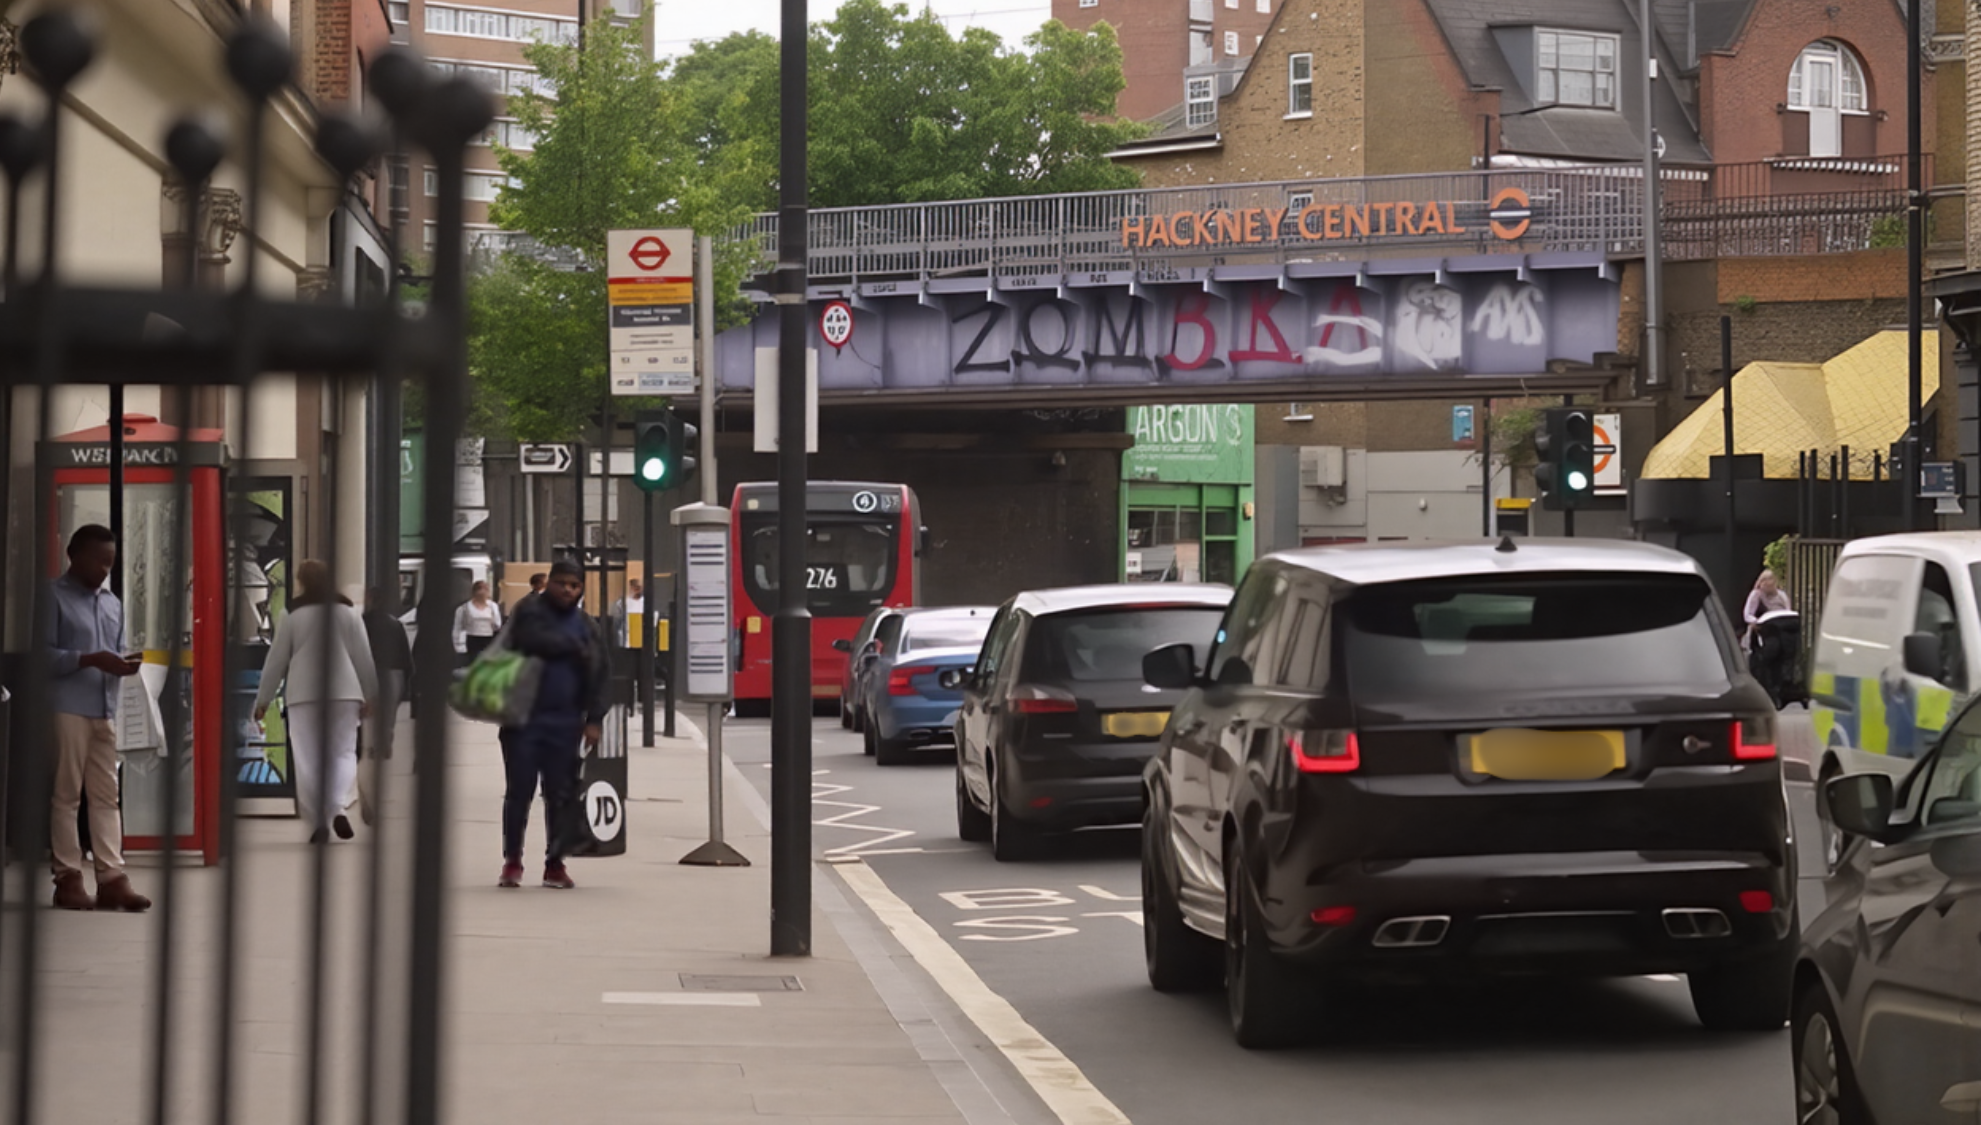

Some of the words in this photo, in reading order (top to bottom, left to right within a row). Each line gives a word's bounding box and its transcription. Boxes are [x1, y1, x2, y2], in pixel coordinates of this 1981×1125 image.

[1121, 207, 1288, 248] HACKNEY
[1297, 200, 1466, 240] CENTRAL
[806, 567, 837, 589] 276
[593, 795, 618, 828] JD
